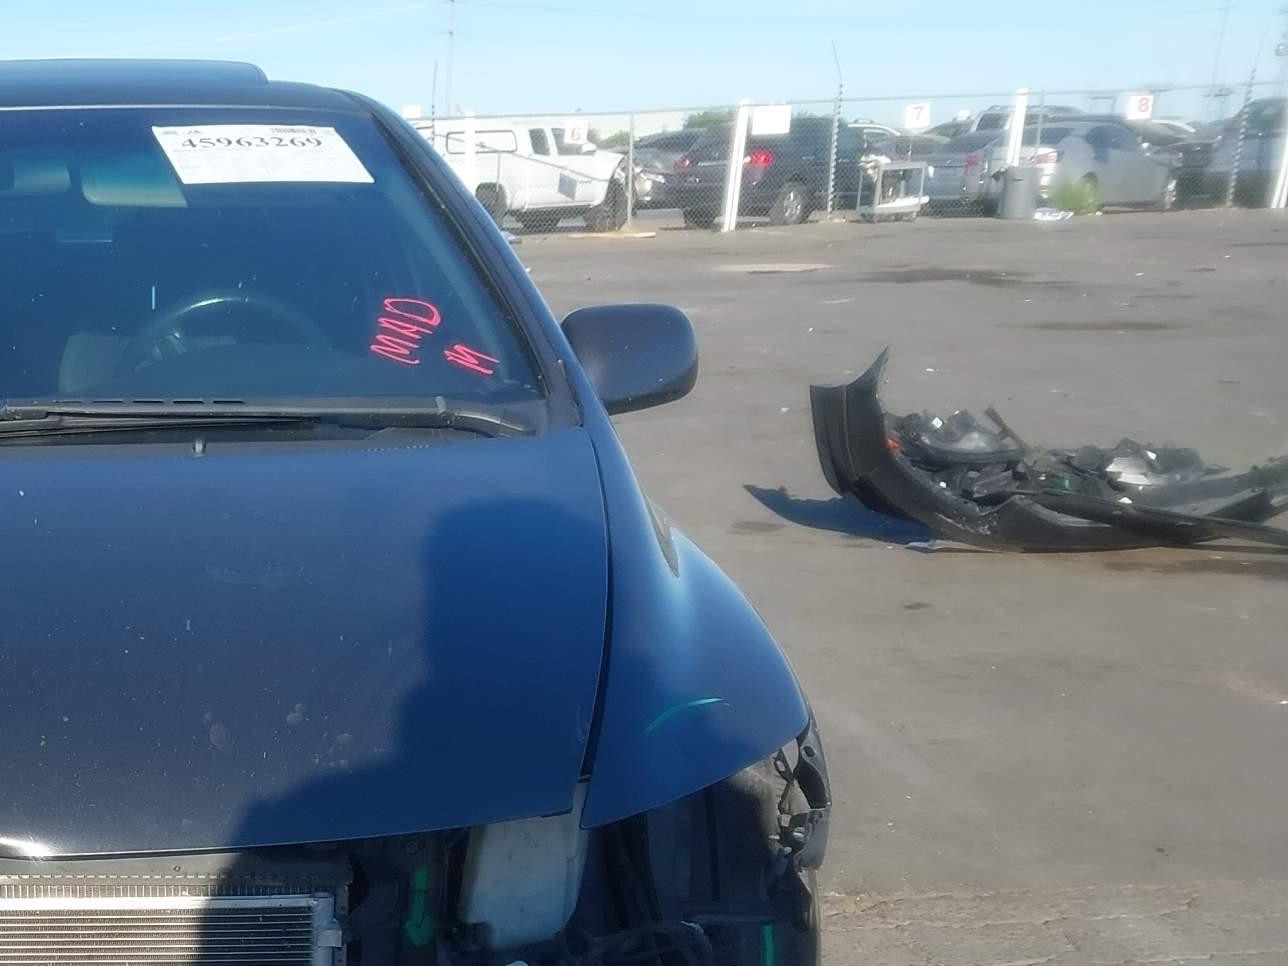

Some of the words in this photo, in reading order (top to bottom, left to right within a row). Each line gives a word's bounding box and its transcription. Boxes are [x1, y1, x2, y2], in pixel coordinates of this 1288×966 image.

[1137, 97, 1150, 112] 8
[913, 106, 924, 121] 7
[570, 126, 582, 142] 6
[181, 136, 323, 149] 45963269
